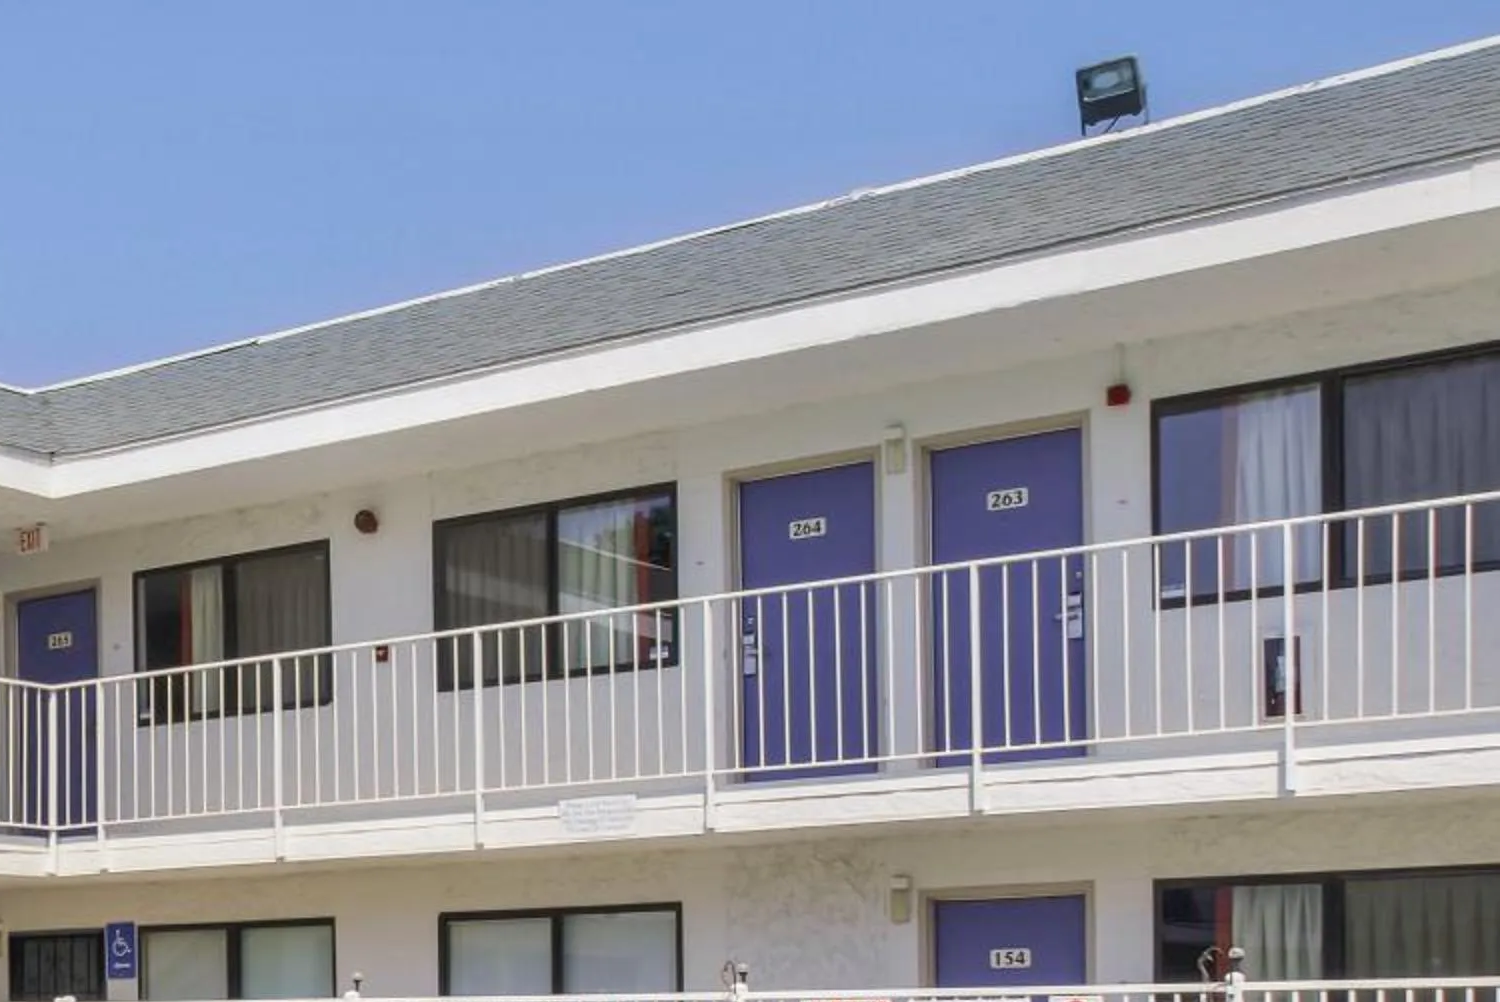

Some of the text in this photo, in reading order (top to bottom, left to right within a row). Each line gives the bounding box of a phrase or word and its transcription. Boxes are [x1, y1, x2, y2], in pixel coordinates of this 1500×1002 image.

[991, 490, 1023, 508] 263
[793, 521, 821, 536] 264
[19, 527, 42, 552] EXIT
[995, 952, 1025, 966] 154
